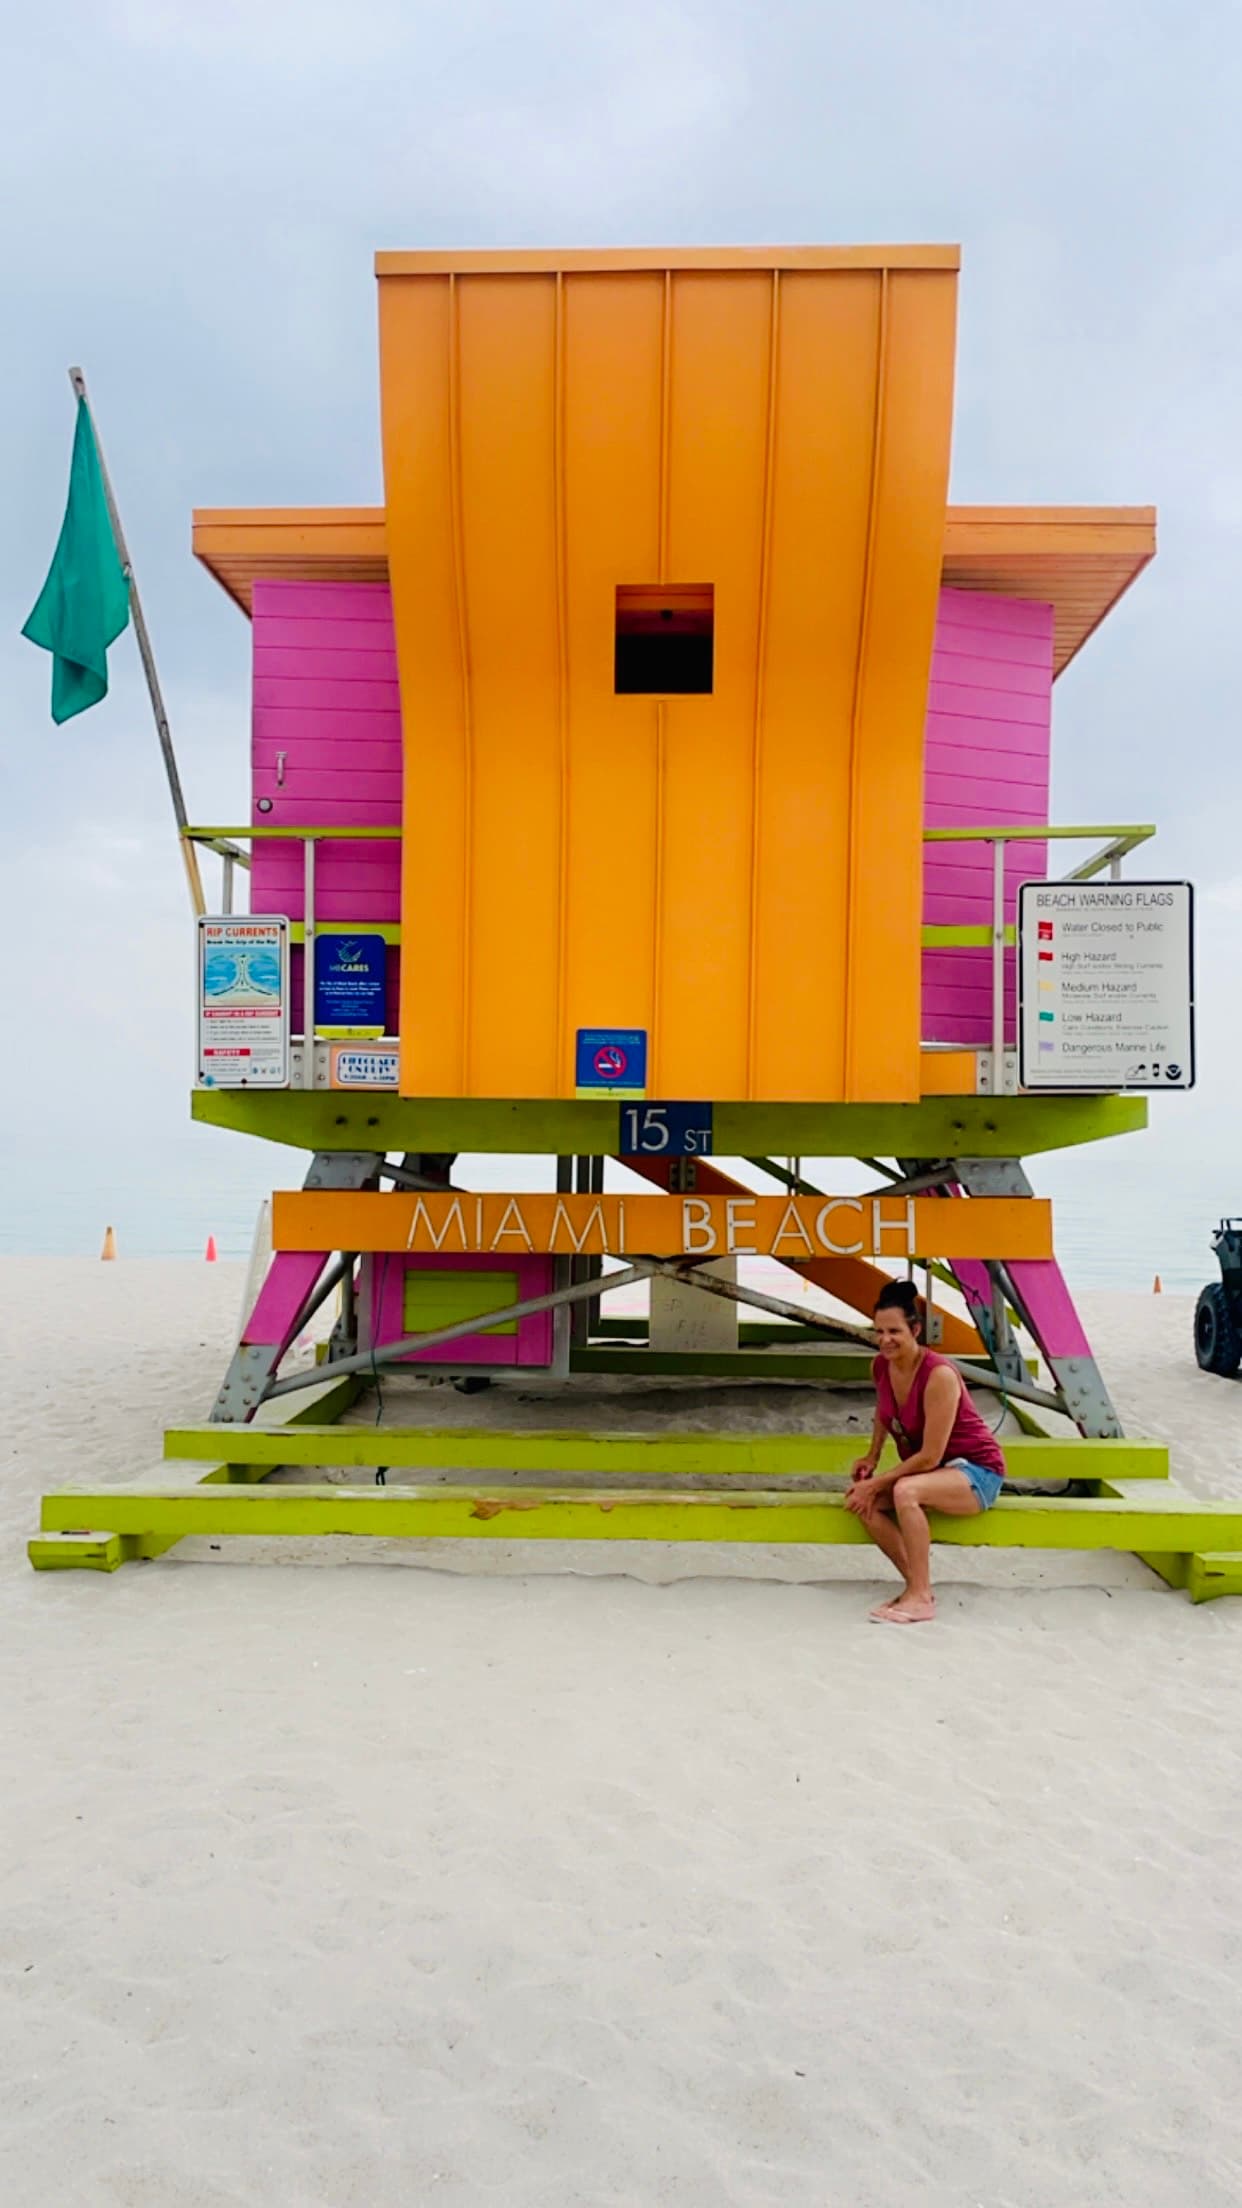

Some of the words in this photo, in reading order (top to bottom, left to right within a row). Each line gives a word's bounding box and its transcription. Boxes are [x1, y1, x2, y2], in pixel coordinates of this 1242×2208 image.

[1037, 894, 1075, 907] BEACH
[1080, 893, 1133, 906] WARNING
[1136, 892, 1174, 906] FLAGS
[207, 927, 223, 936] RIP
[226, 927, 278, 937] CURRENTS
[1062, 922, 1089, 932] Water
[1091, 922, 1123, 932] Closed
[1125, 922, 1134, 932] to
[1136, 921, 1164, 932] Public
[1062, 952, 1080, 962] High
[1084, 951, 1117, 961] Hazard
[1062, 983, 1098, 992] Medium
[1102, 983, 1137, 993] Hazard
[1062, 1013, 1082, 1022] Low
[1086, 1012, 1122, 1022] Hazard
[1062, 1042, 1112, 1054] Dangerous
[1115, 1042, 1147, 1052] Marine
[1149, 1042, 1166, 1052] Life
[626, 1108, 669, 1151] 15
[684, 1129, 712, 1152] ST
[407, 1198, 625, 1252] MIAMI
[682, 1198, 917, 1256] BEACH
